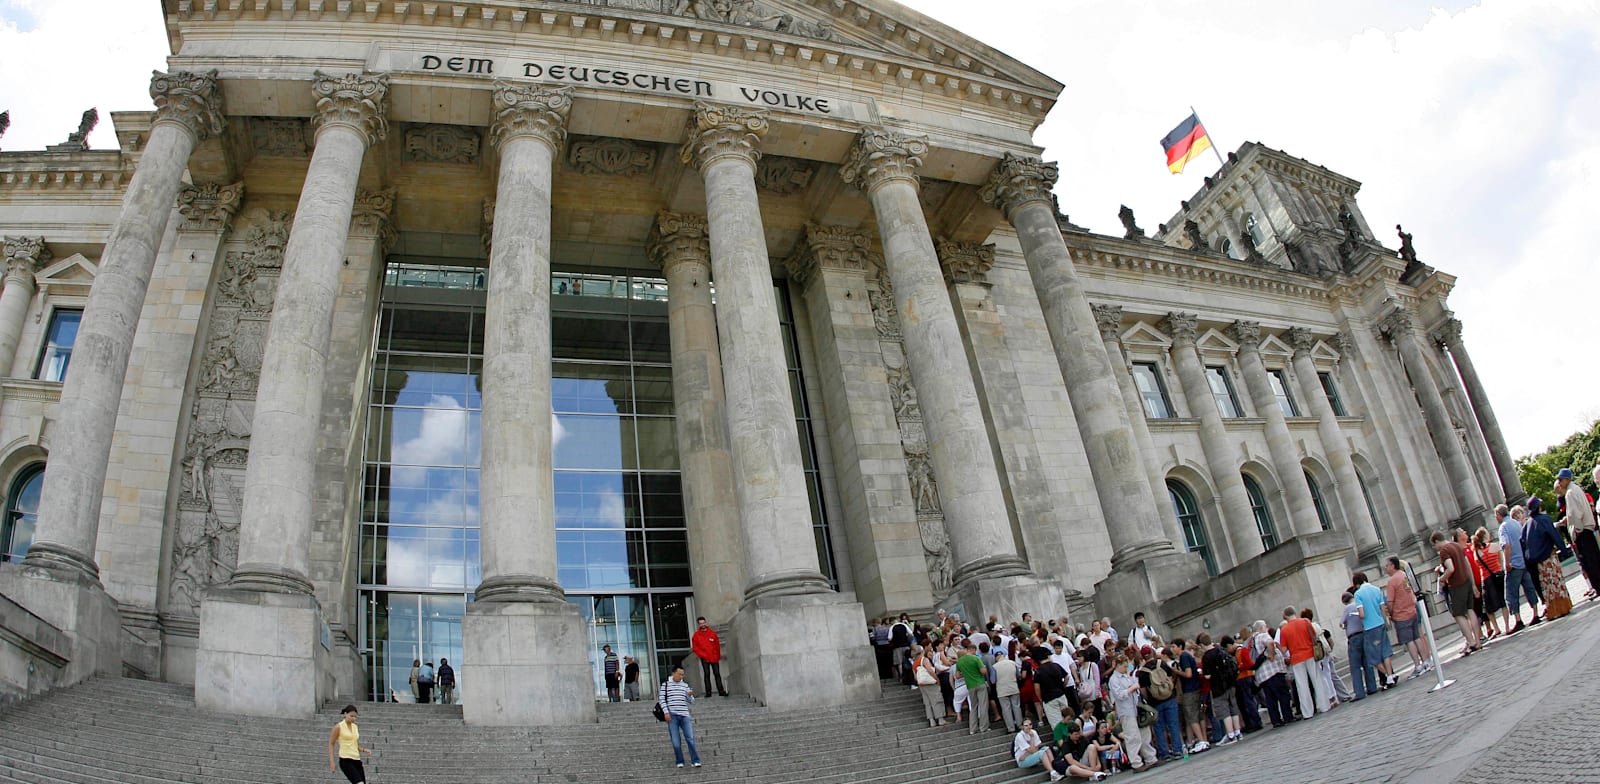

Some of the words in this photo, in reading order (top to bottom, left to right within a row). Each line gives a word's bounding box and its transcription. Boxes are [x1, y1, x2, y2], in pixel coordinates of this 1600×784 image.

[421, 55, 494, 74] DEM
[522, 62, 713, 97] DEUTSCHEN
[739, 87, 831, 114] VOLKE
